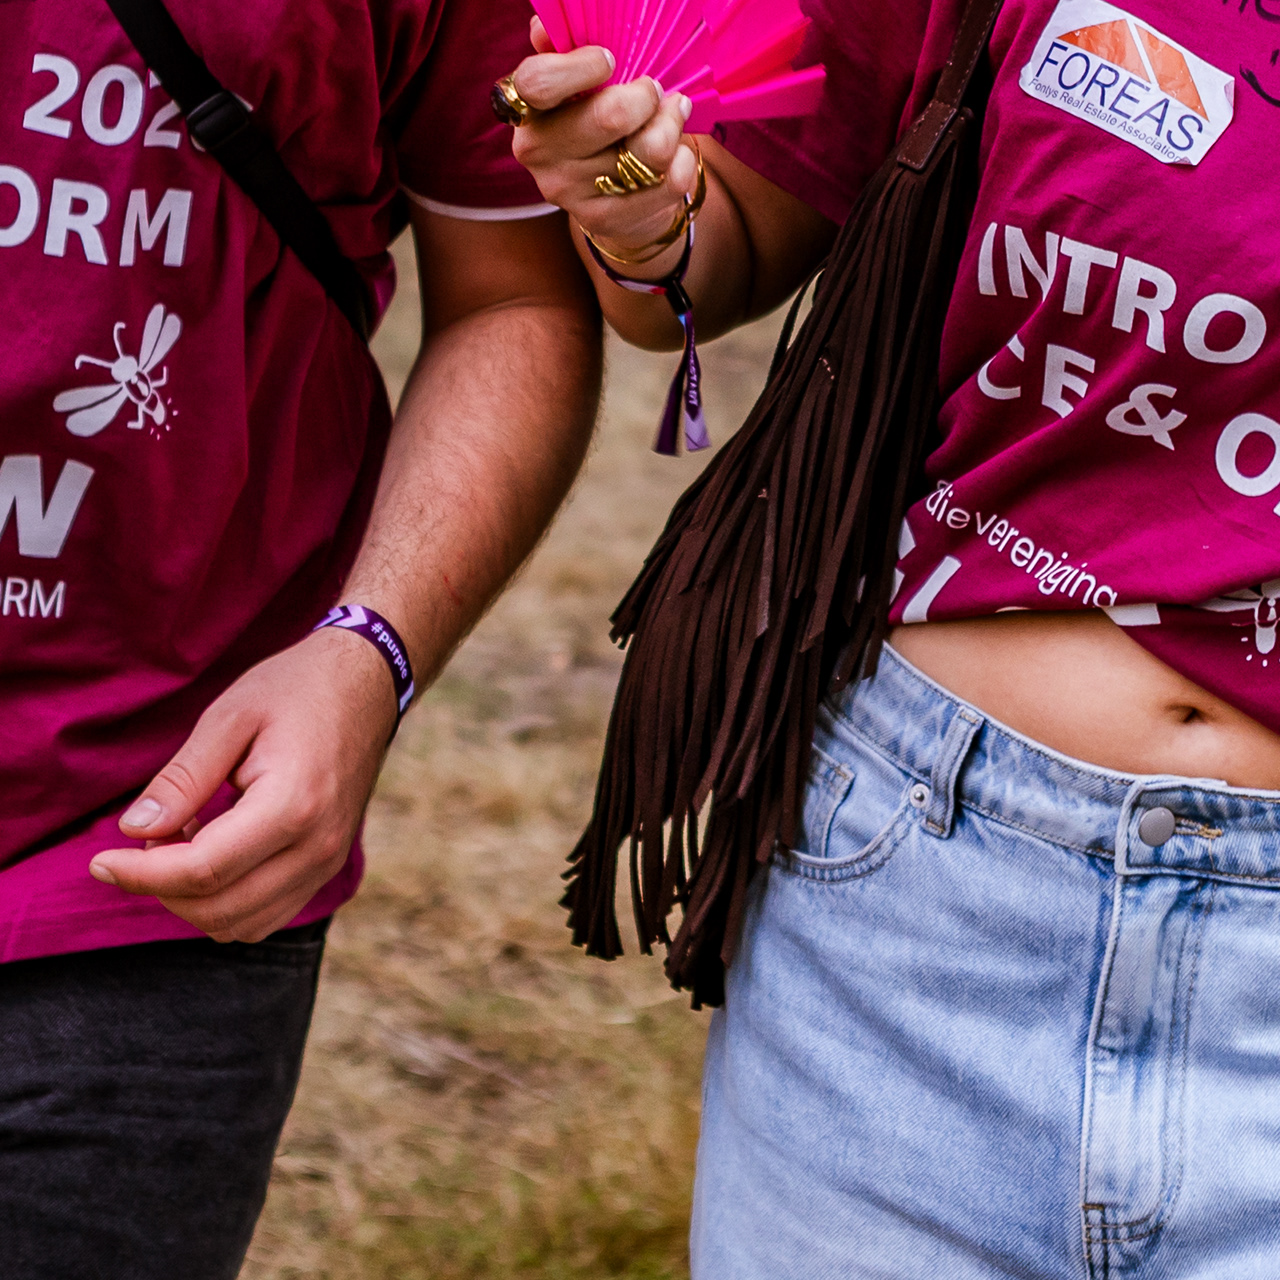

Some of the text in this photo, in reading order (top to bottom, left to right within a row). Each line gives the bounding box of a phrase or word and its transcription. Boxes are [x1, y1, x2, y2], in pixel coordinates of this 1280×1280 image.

[1028, 78, 1058, 99] Fontys
[1059, 93, 1083, 110] Real
[1083, 103, 1118, 128] Estate
[1035, 41, 1204, 151] FOREAS
[977, 222, 1267, 365] INTRO
[977, 333, 1096, 419] CE
[1105, 382, 1188, 451] &
[371, 622, 408, 680] #purple
